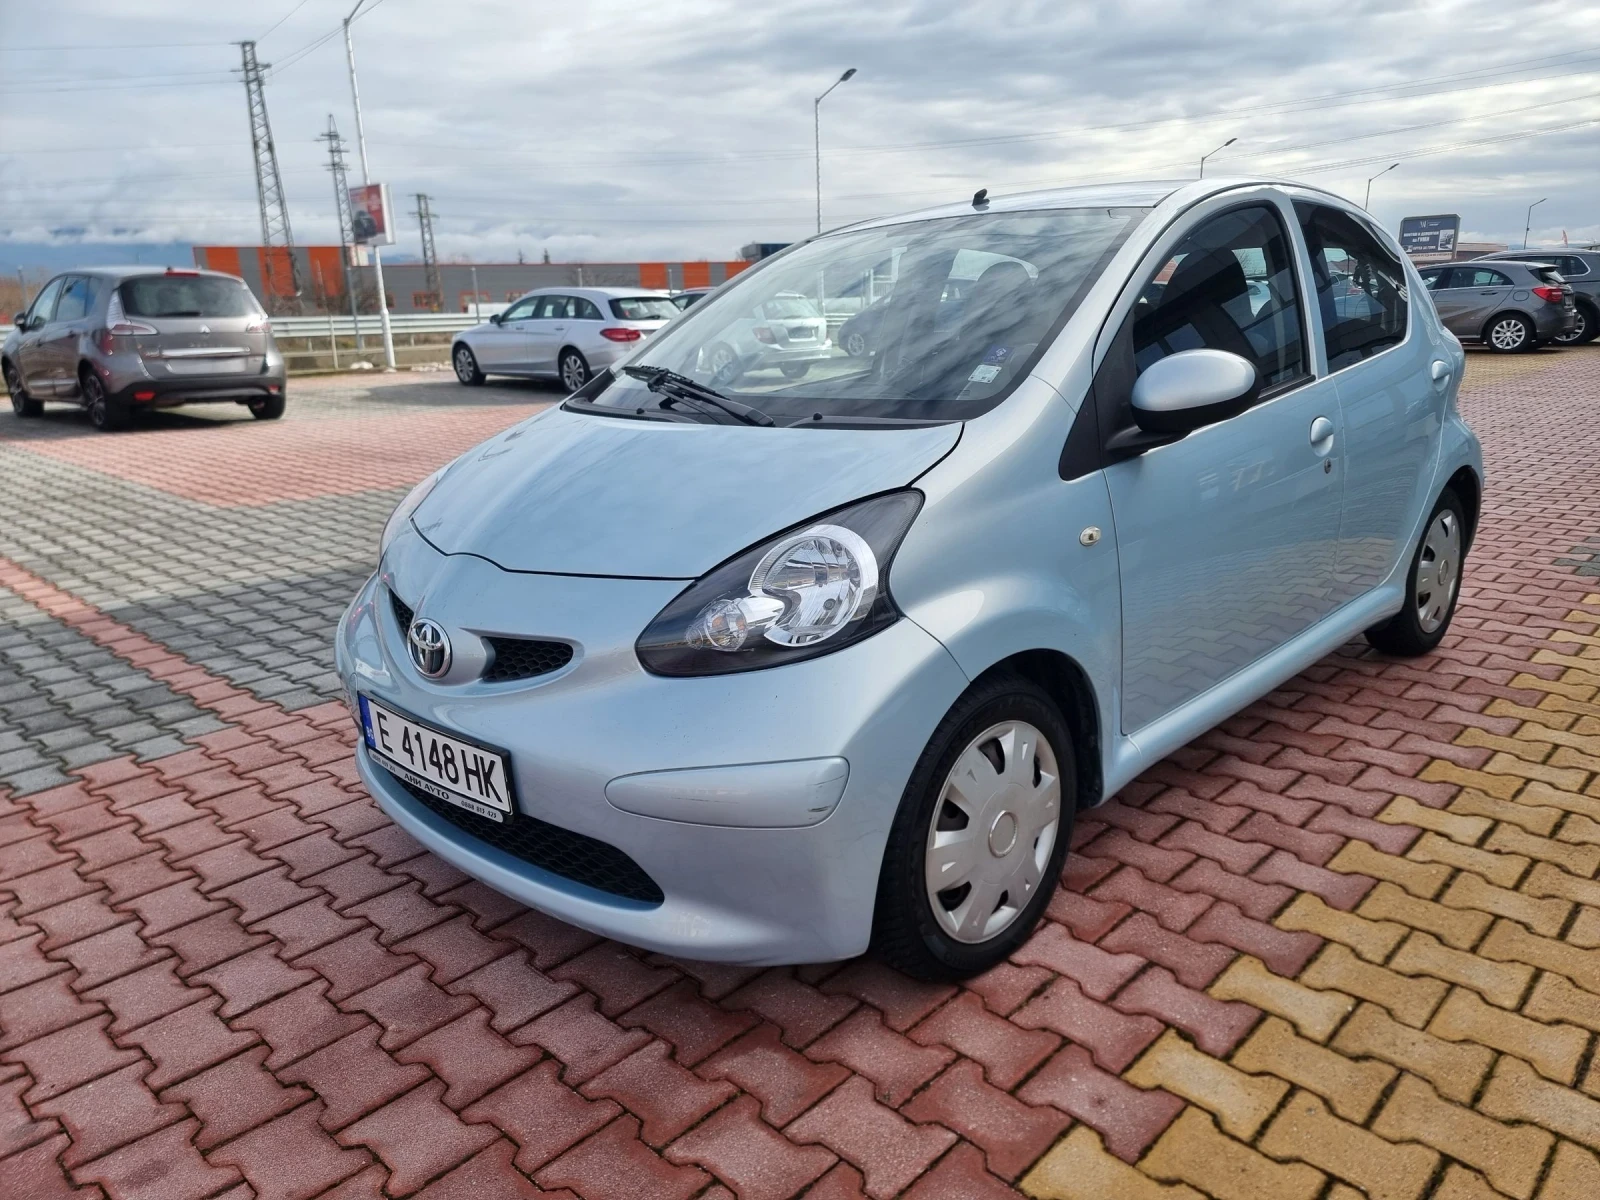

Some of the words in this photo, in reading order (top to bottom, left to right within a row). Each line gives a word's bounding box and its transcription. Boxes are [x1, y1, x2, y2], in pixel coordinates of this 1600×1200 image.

[376, 711, 394, 754] E
[402, 726, 459, 785] 4148
[461, 749, 504, 804] HK
[404, 773, 422, 788] АНИ
